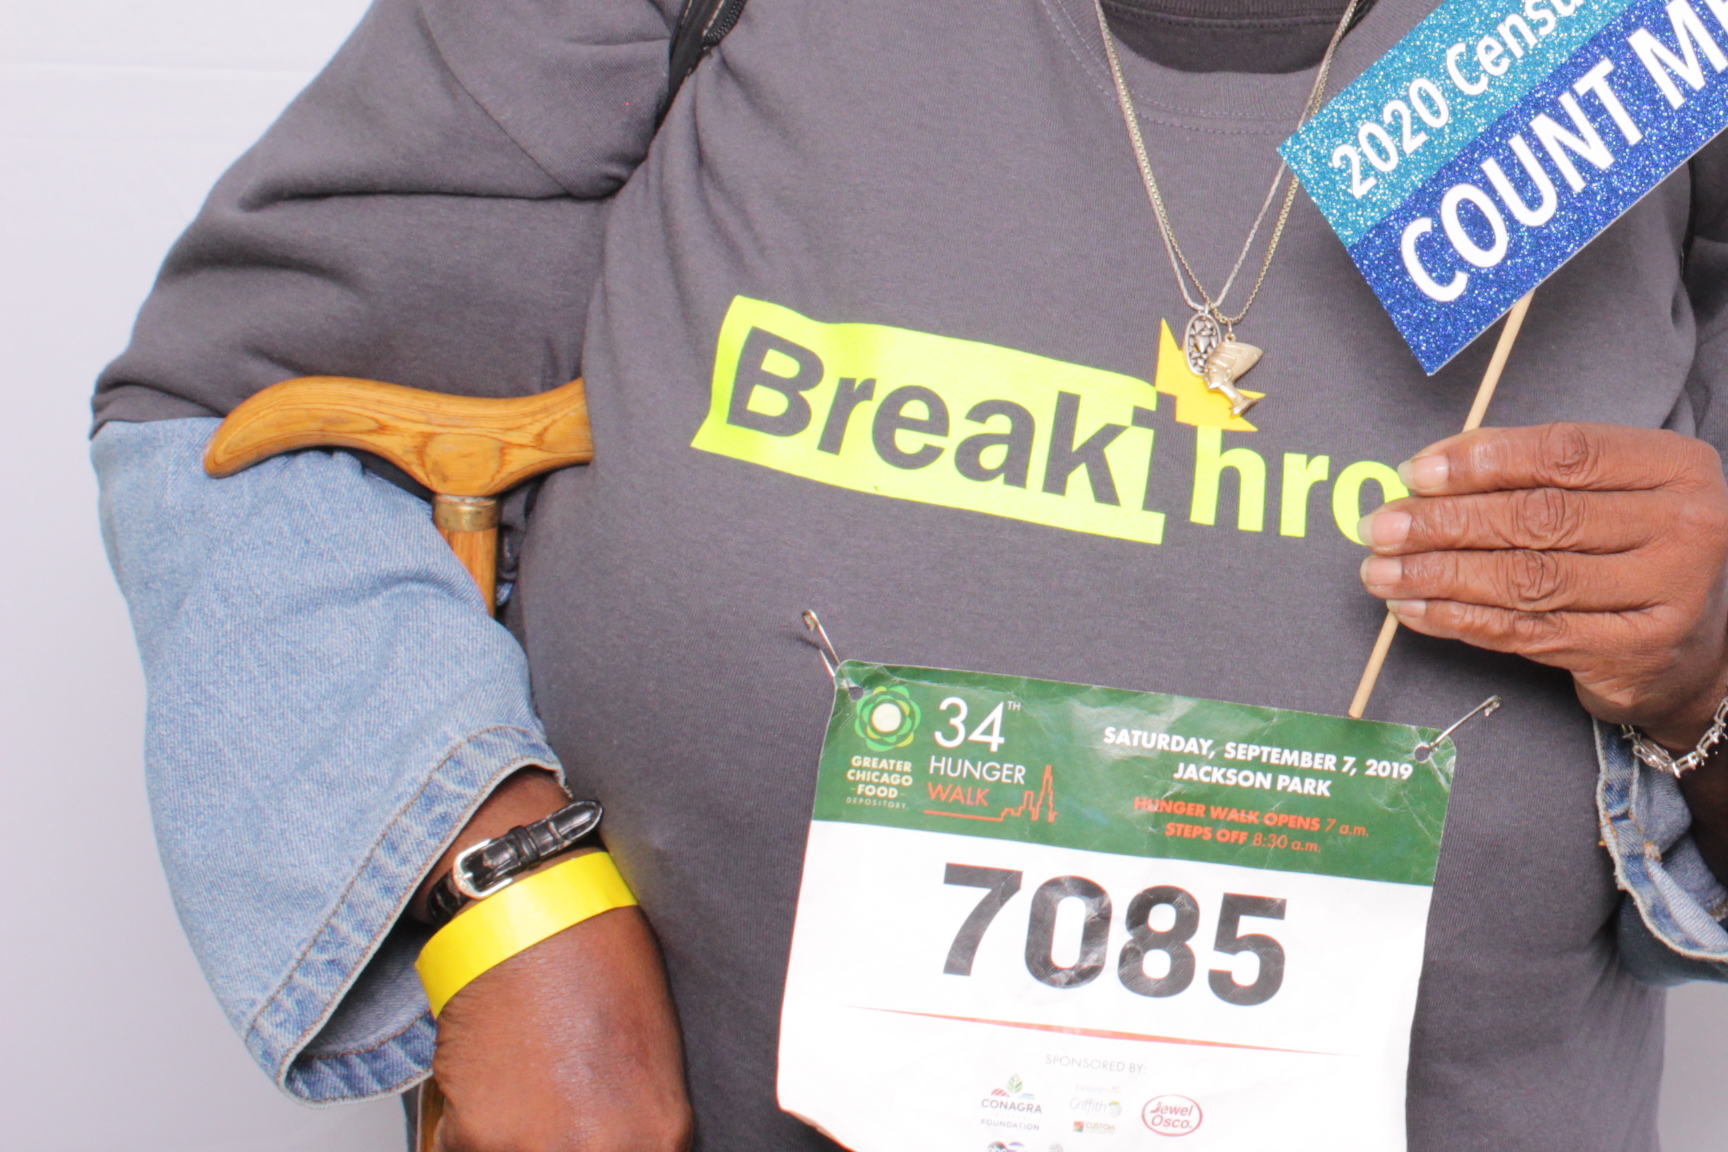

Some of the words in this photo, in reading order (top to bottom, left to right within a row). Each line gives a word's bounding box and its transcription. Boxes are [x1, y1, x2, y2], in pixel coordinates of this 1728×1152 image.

[1331, 77, 1449, 200] 2020
[1400, 57, 1644, 303] COUNT
[851, 755, 912, 772] GREATER
[1103, 726, 1215, 759] SATURDAY,
[1223, 741, 1336, 772] SEPTEMBER
[1340, 756, 1357, 776] 7,
[1364, 758, 1413, 780] 2019
[846, 769, 913, 787] CHICAGO
[929, 755, 1026, 785] HUNGER
[1173, 762, 1272, 789] JACKSON
[1276, 774, 1332, 797] PARK
[857, 783, 898, 798] FOOD
[927, 782, 991, 807] WALK
[1133, 796, 1206, 817] HUNGER
[1209, 805, 1259, 824] WALK
[1263, 812, 1320, 831] OPENS
[1325, 818, 1337, 832] 7
[1339, 822, 1369, 837] a.m.
[1165, 822, 1212, 840] STEPS
[1215, 828, 1249, 845] OFF
[1252, 832, 1288, 848] 8:30
[1291, 838, 1321, 852] a.m.
[943, 861, 1288, 1008] 7085
[1045, 1054, 1125, 1073] SPONSORED
[981, 1098, 1042, 1114] CONAGRA
[1069, 1097, 1107, 1115] Griffith
[1150, 1100, 1193, 1116] Jewel
[981, 1119, 1040, 1131] FOUNDATION
